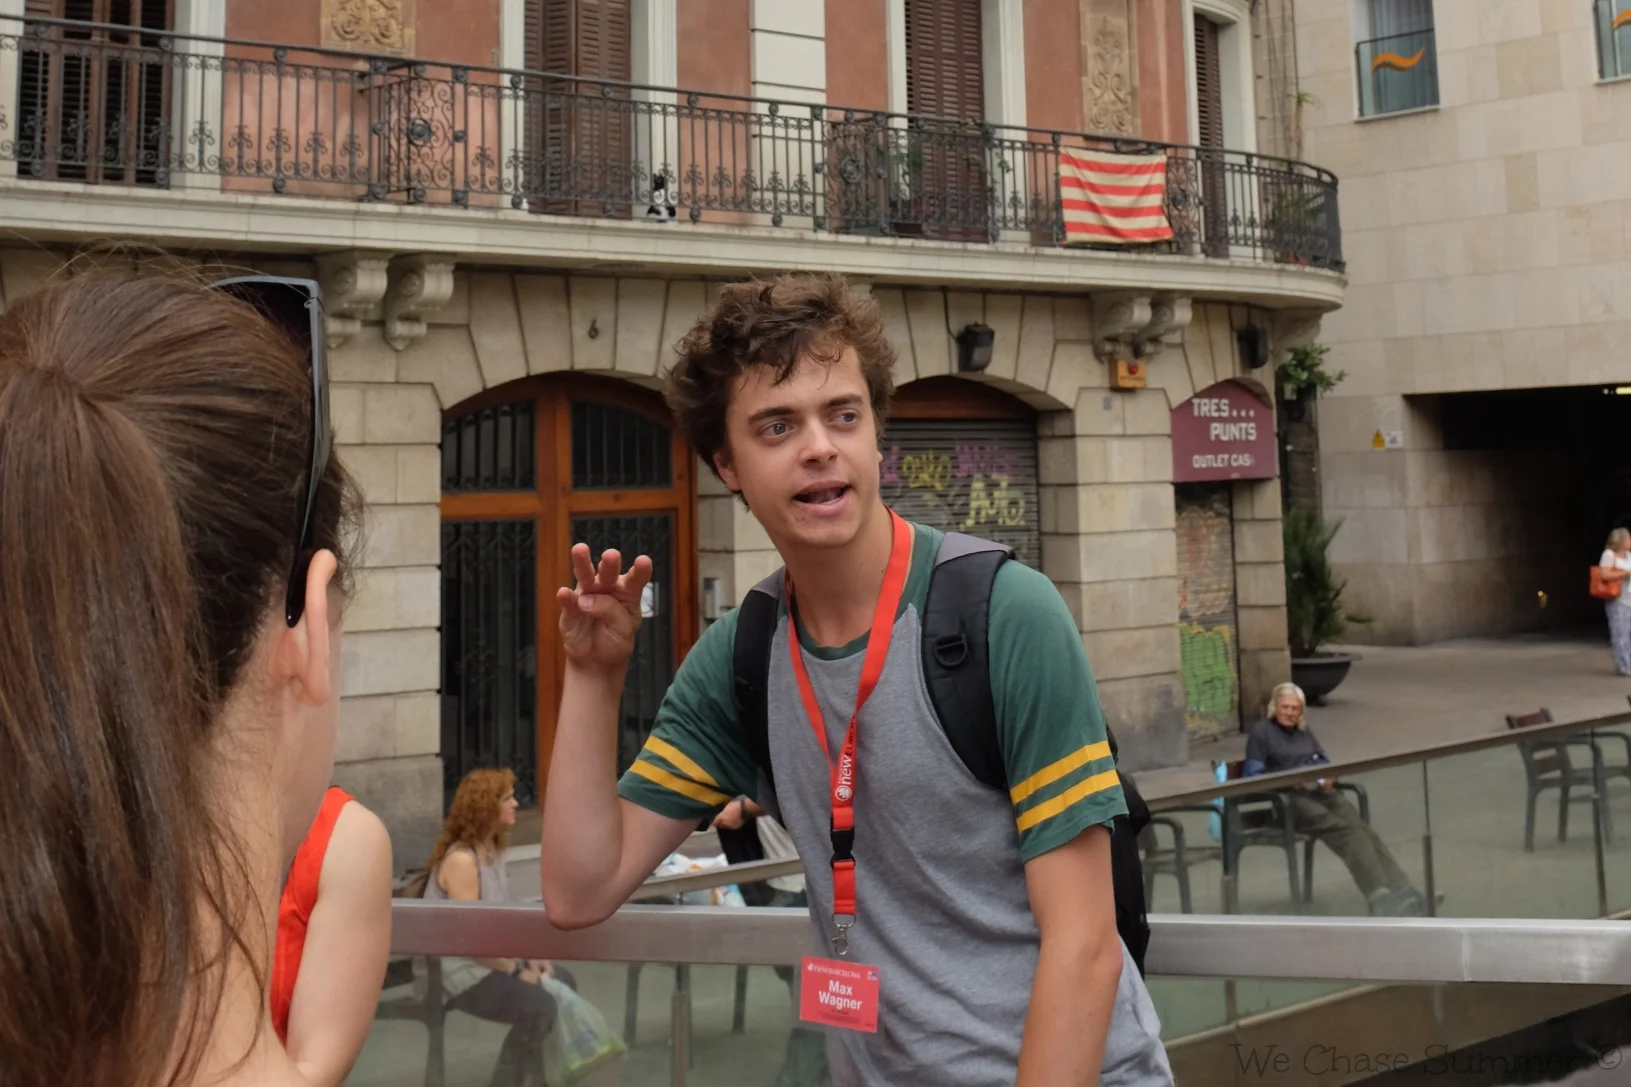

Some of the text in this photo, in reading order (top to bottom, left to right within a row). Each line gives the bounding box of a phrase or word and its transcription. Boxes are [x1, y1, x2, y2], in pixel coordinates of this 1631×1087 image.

[1210, 422, 1256, 441] PUNTS
[1192, 454, 1229, 468] OUTLET
[829, 979, 853, 996] Max
[818, 990, 863, 1010] Wagner
